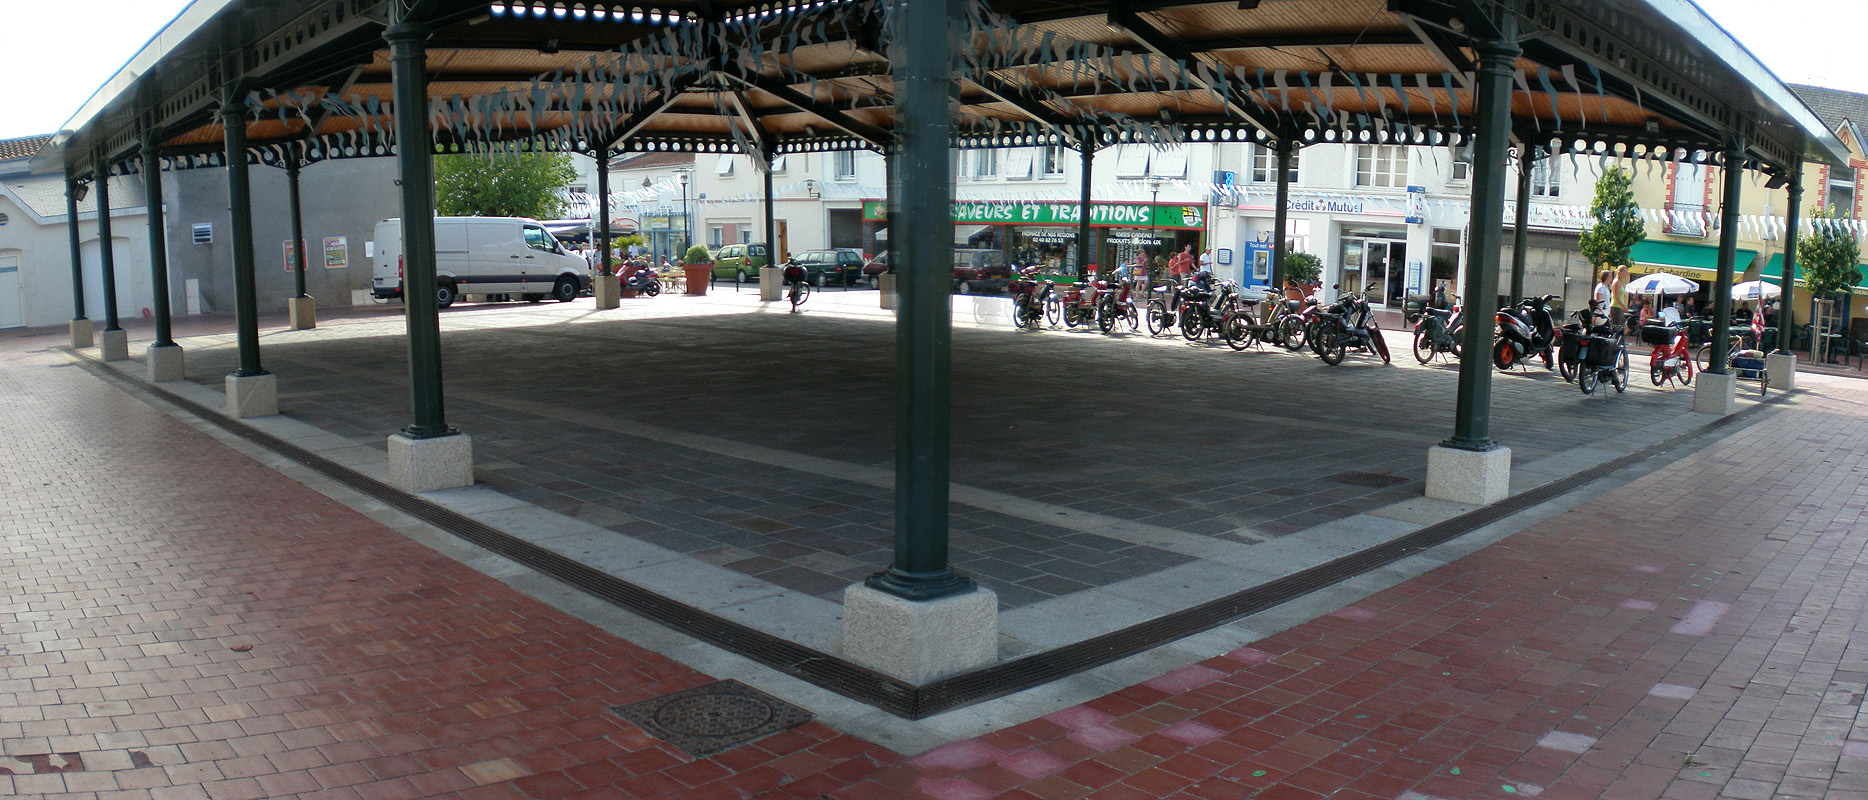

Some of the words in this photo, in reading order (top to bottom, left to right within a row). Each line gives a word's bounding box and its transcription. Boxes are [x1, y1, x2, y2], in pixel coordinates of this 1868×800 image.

[1020, 204, 1040, 220] ET
[1049, 204, 1149, 222] TRAITIONS
[1286, 200, 1314, 210] Crédit
[1327, 201, 1363, 213] Mutuel
[1644, 266, 1655, 274] La
[1657, 267, 1702, 279] Gabardine
